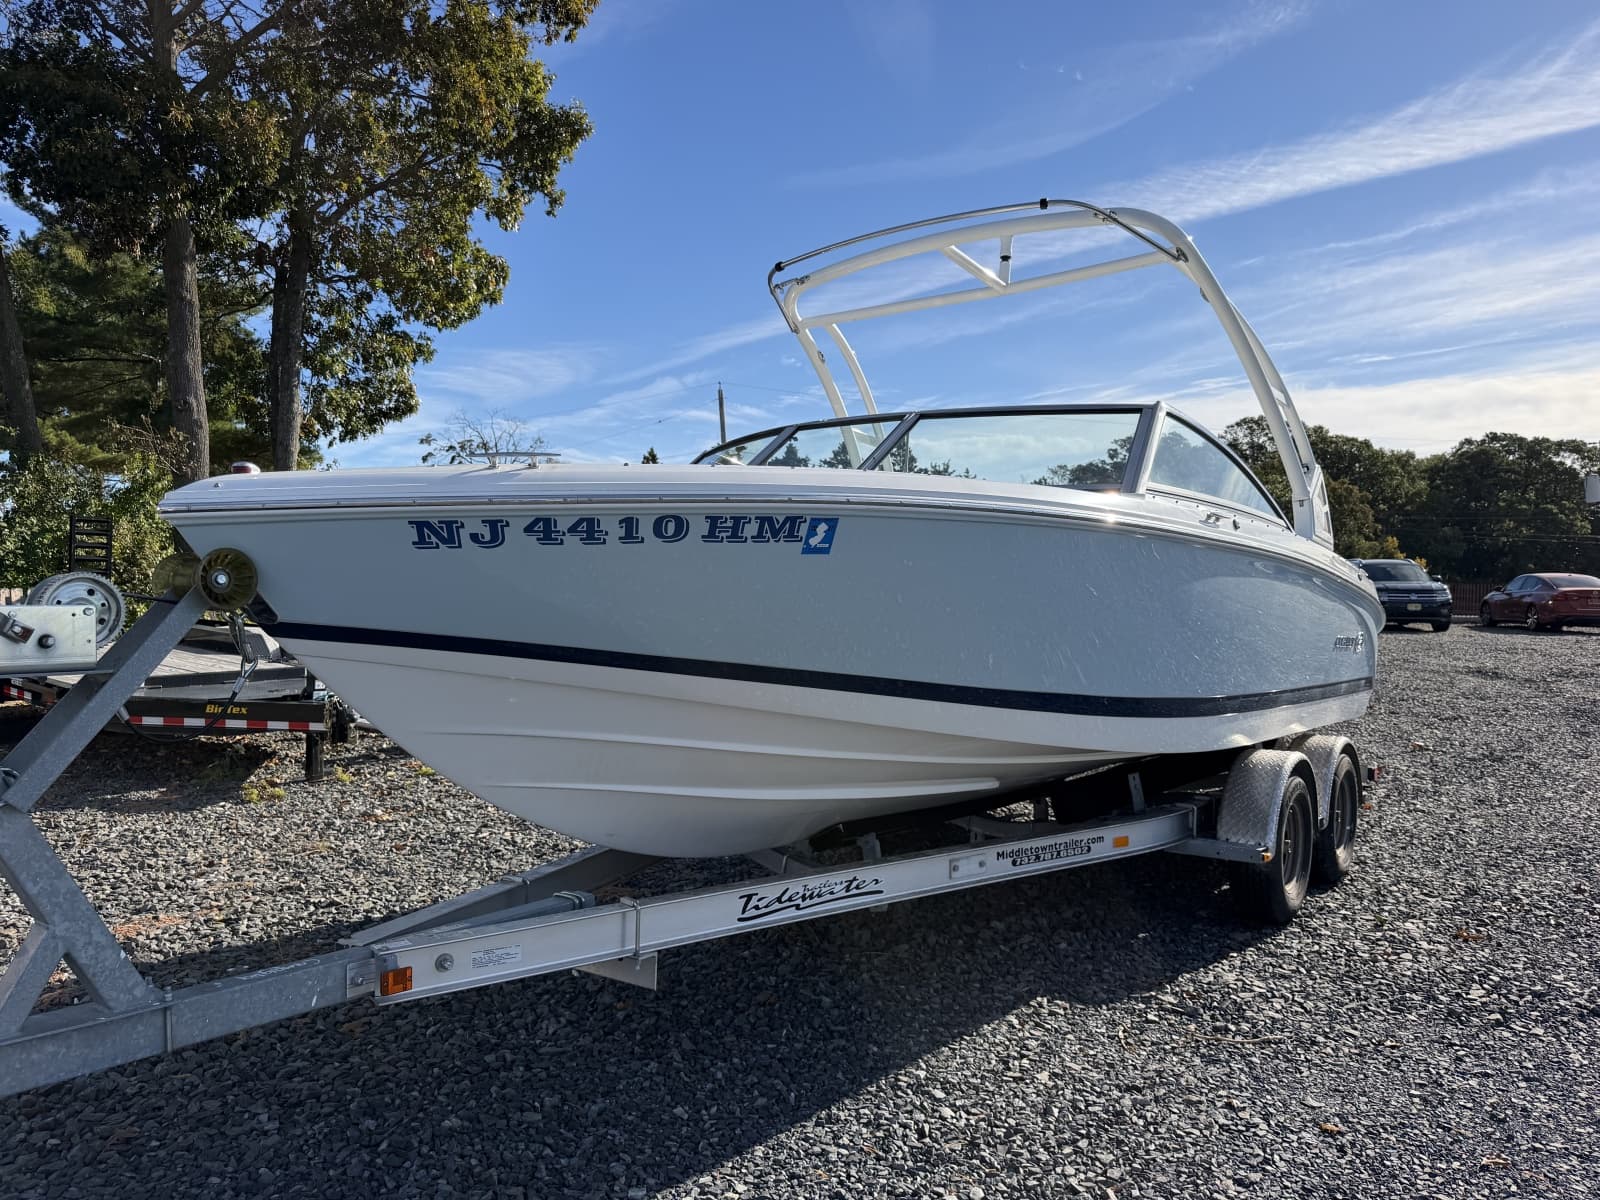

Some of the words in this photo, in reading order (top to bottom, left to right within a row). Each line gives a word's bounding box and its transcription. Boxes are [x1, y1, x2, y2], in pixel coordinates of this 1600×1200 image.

[408, 518, 510, 549] NJ
[523, 515, 690, 545] 4410
[701, 515, 807, 543] HM
[996, 835, 1105, 861] Middletowntrailer.com
[738, 875, 883, 915] Tidewater
